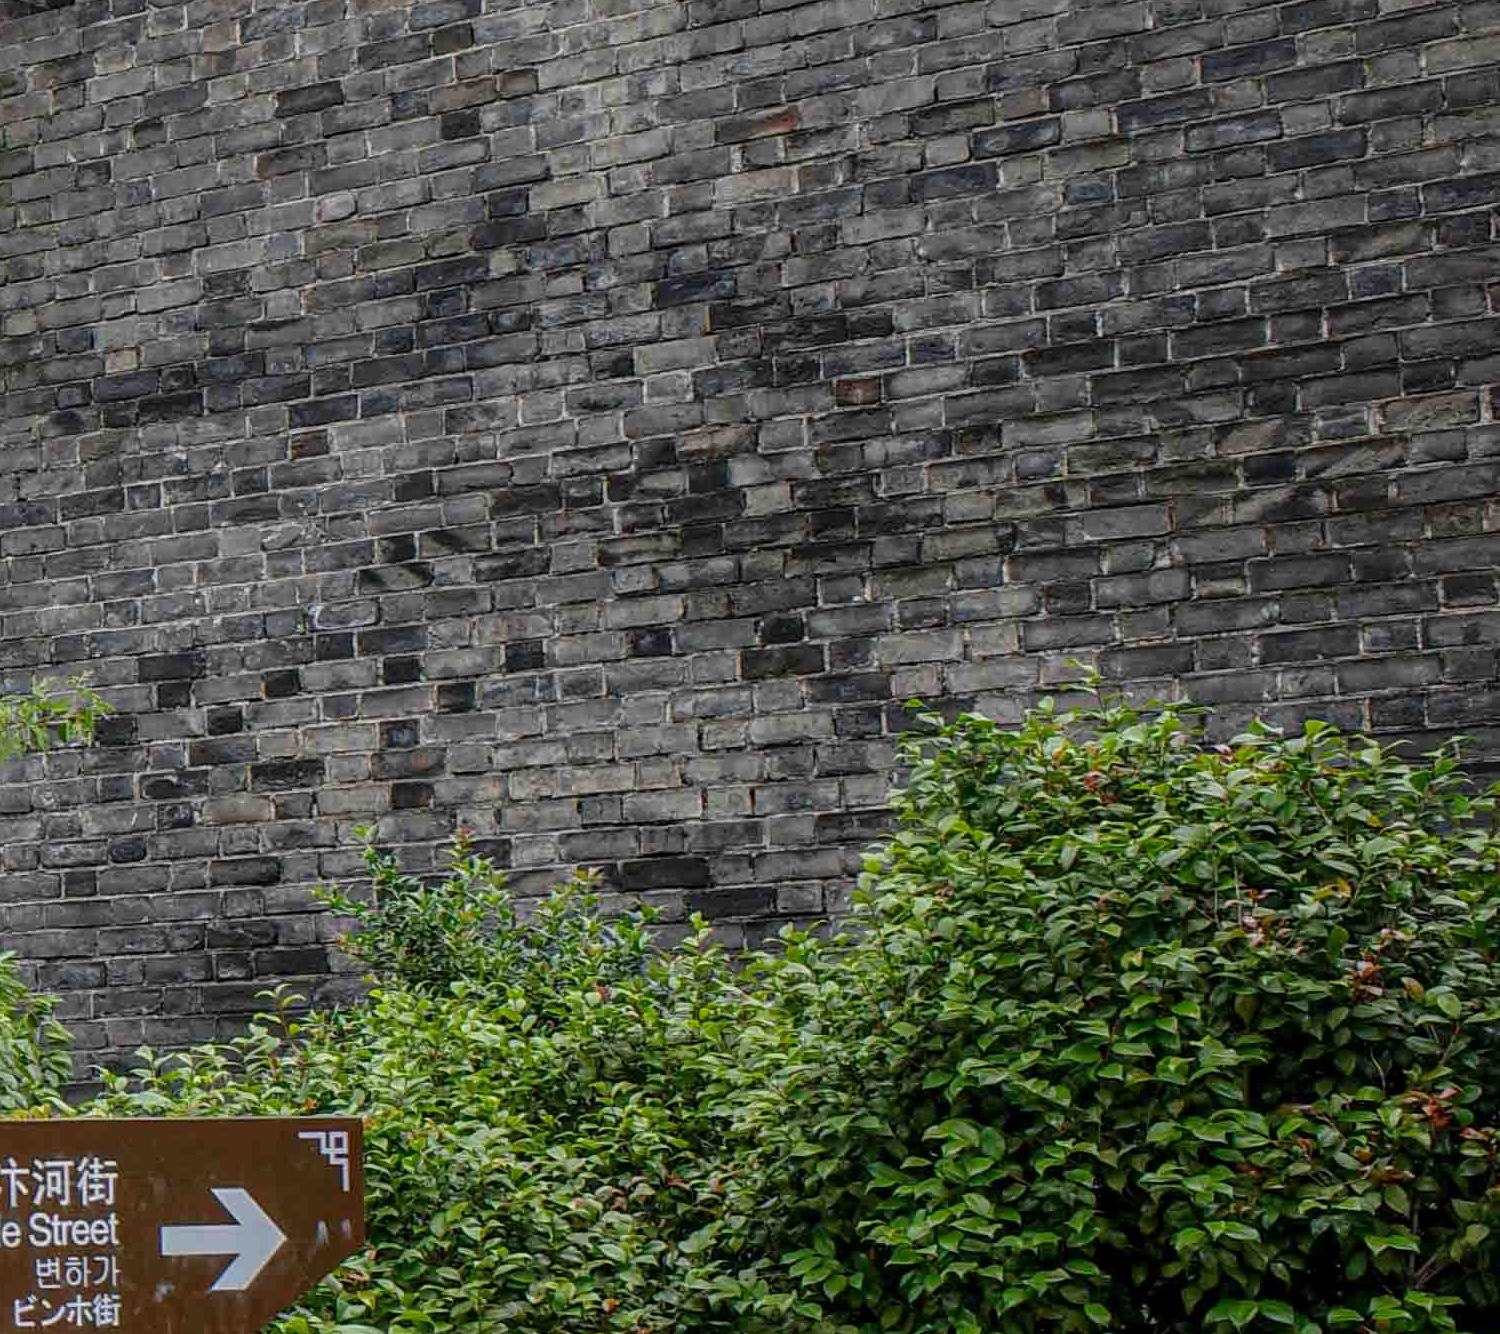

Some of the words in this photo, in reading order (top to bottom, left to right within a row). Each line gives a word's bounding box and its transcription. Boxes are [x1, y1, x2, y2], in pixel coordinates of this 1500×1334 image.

[28, 1212, 120, 1247] Street
[36, 1256, 121, 1289] 변하가
[14, 1293, 122, 1327] ビンホ街
